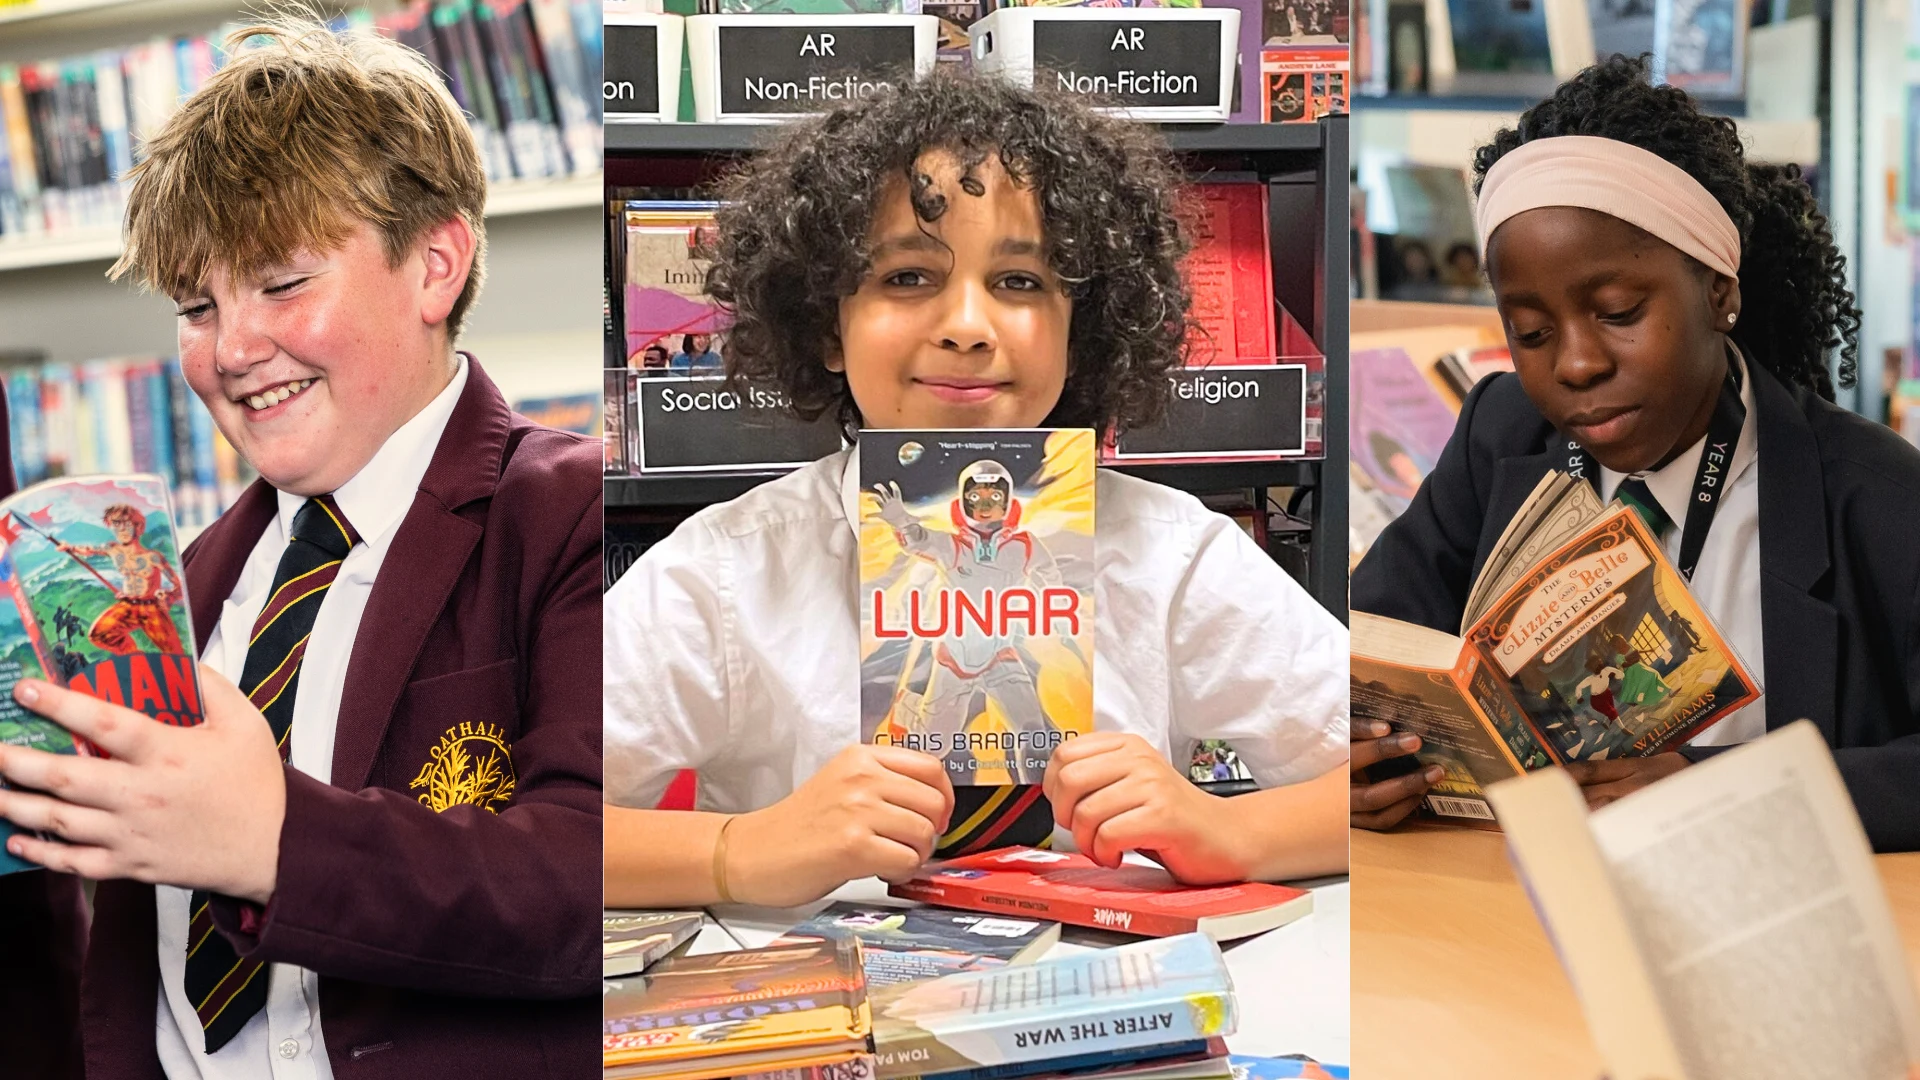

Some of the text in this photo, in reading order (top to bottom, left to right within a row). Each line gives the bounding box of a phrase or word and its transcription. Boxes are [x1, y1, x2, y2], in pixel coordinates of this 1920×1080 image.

[800, 34, 836, 57] AR
[1111, 28, 1145, 51] AR
[1057, 70, 1198, 95] Non-Fiction
[1698, 442, 1728, 503] YEAR 8
[1503, 599, 1560, 656] Lizzie
[1569, 551, 1629, 589] Belle
[1540, 578, 1562, 596] THE
[872, 587, 1081, 639] LUNAR
[1534, 578, 1613, 647] MYSTERIES
[1549, 597, 1621, 658] DRAMA AND DANGER
[69, 654, 200, 715] MAN
[1633, 690, 1716, 751] WILLIAMS
[1687, 703, 1717, 725] DOUGLAS
[430, 721, 505, 759] OATHALL
[875, 732, 943, 751] CHRIS
[950, 759, 964, 773] by
[1014, 1012, 1174, 1048] AFTER THE WAR
[873, 1048, 930, 1066] TOM PA
